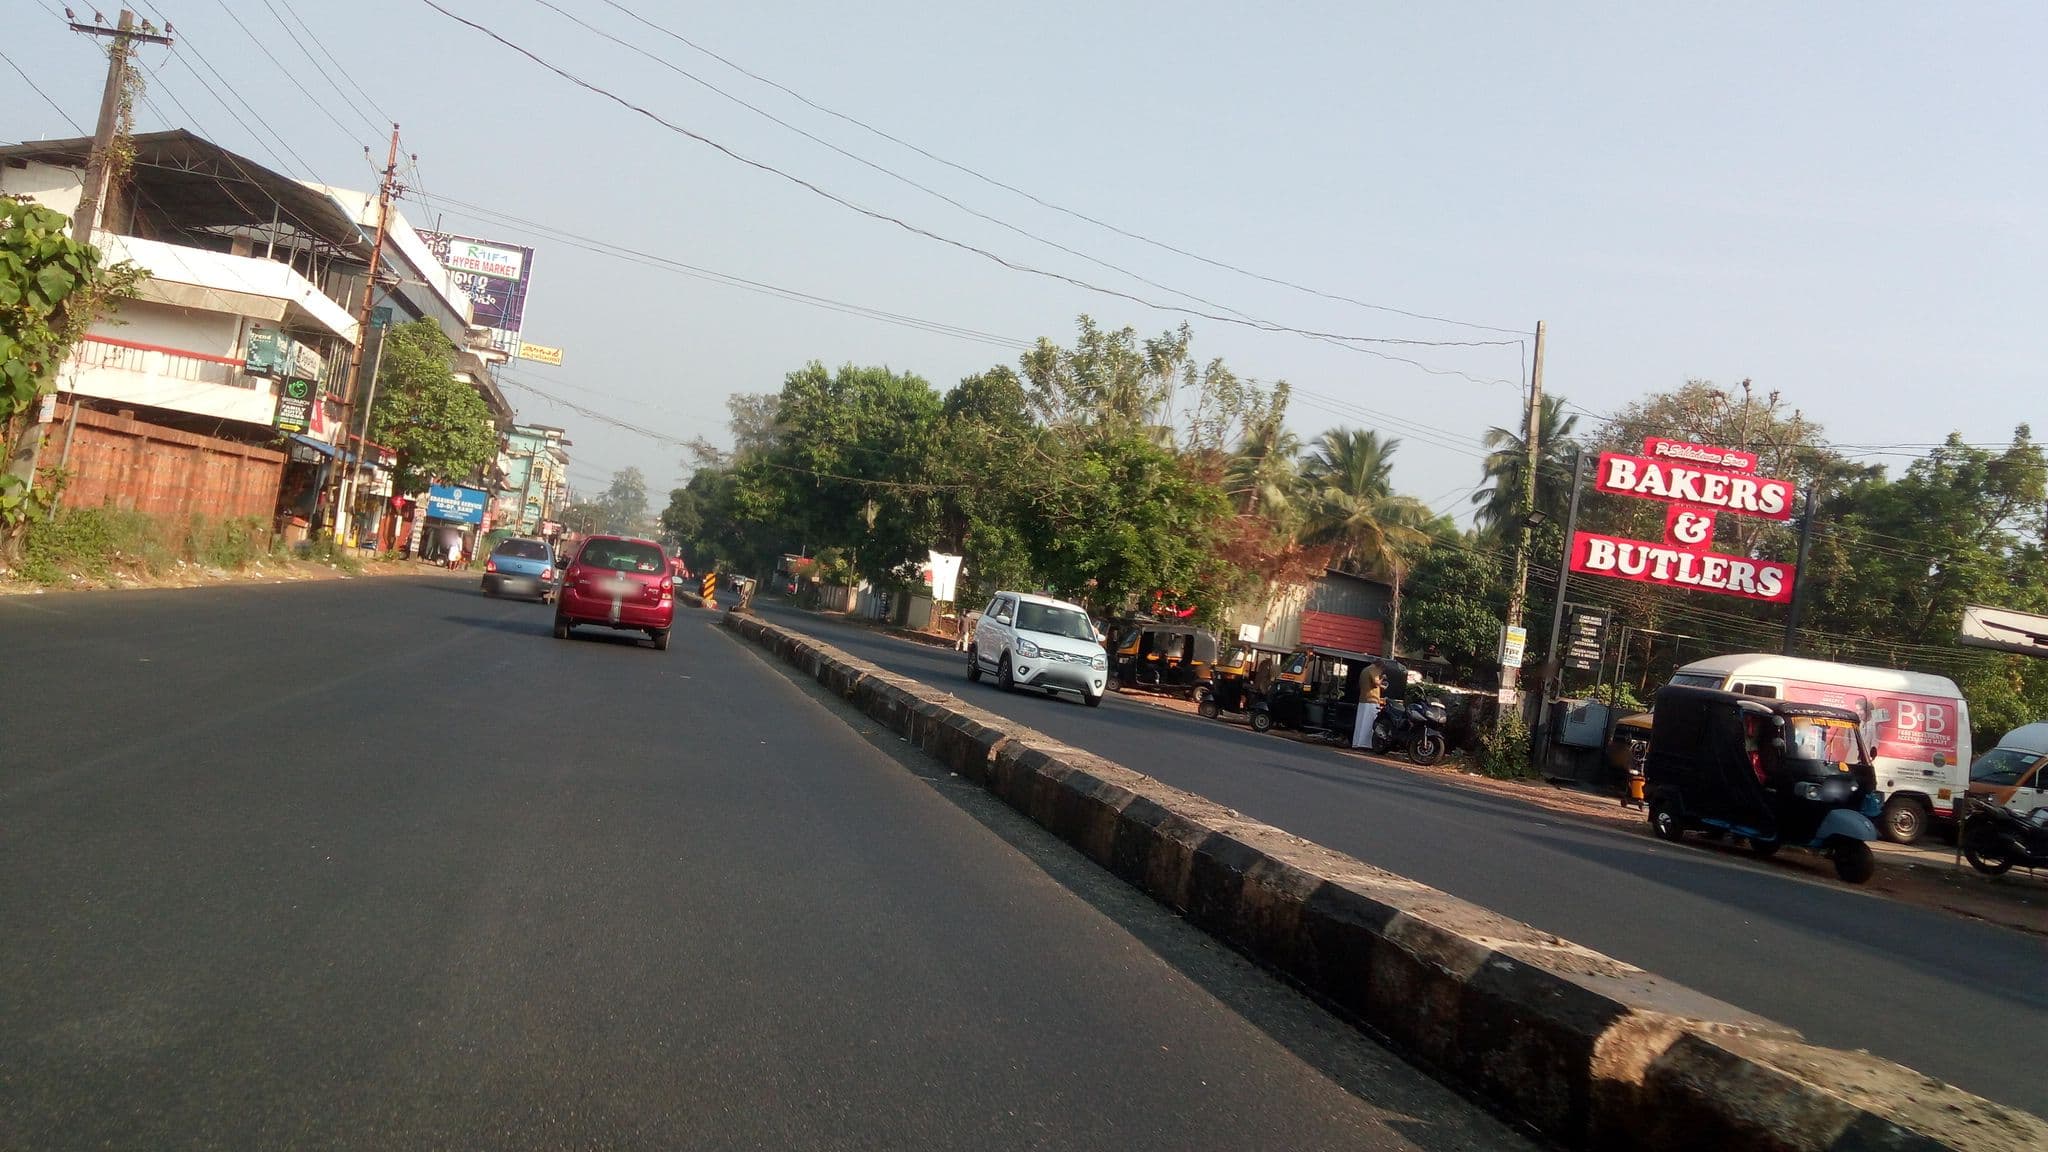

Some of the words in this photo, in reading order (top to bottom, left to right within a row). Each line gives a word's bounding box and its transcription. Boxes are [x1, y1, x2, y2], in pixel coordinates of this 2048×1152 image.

[453, 255, 481, 270] HYPER
[482, 261, 517, 277] MARKET
[282, 404, 306, 412] FAMILY
[1606, 458, 1786, 514] BAKERS
[1674, 512, 1710, 543] &
[1586, 538, 1784, 597] BUTLERS
